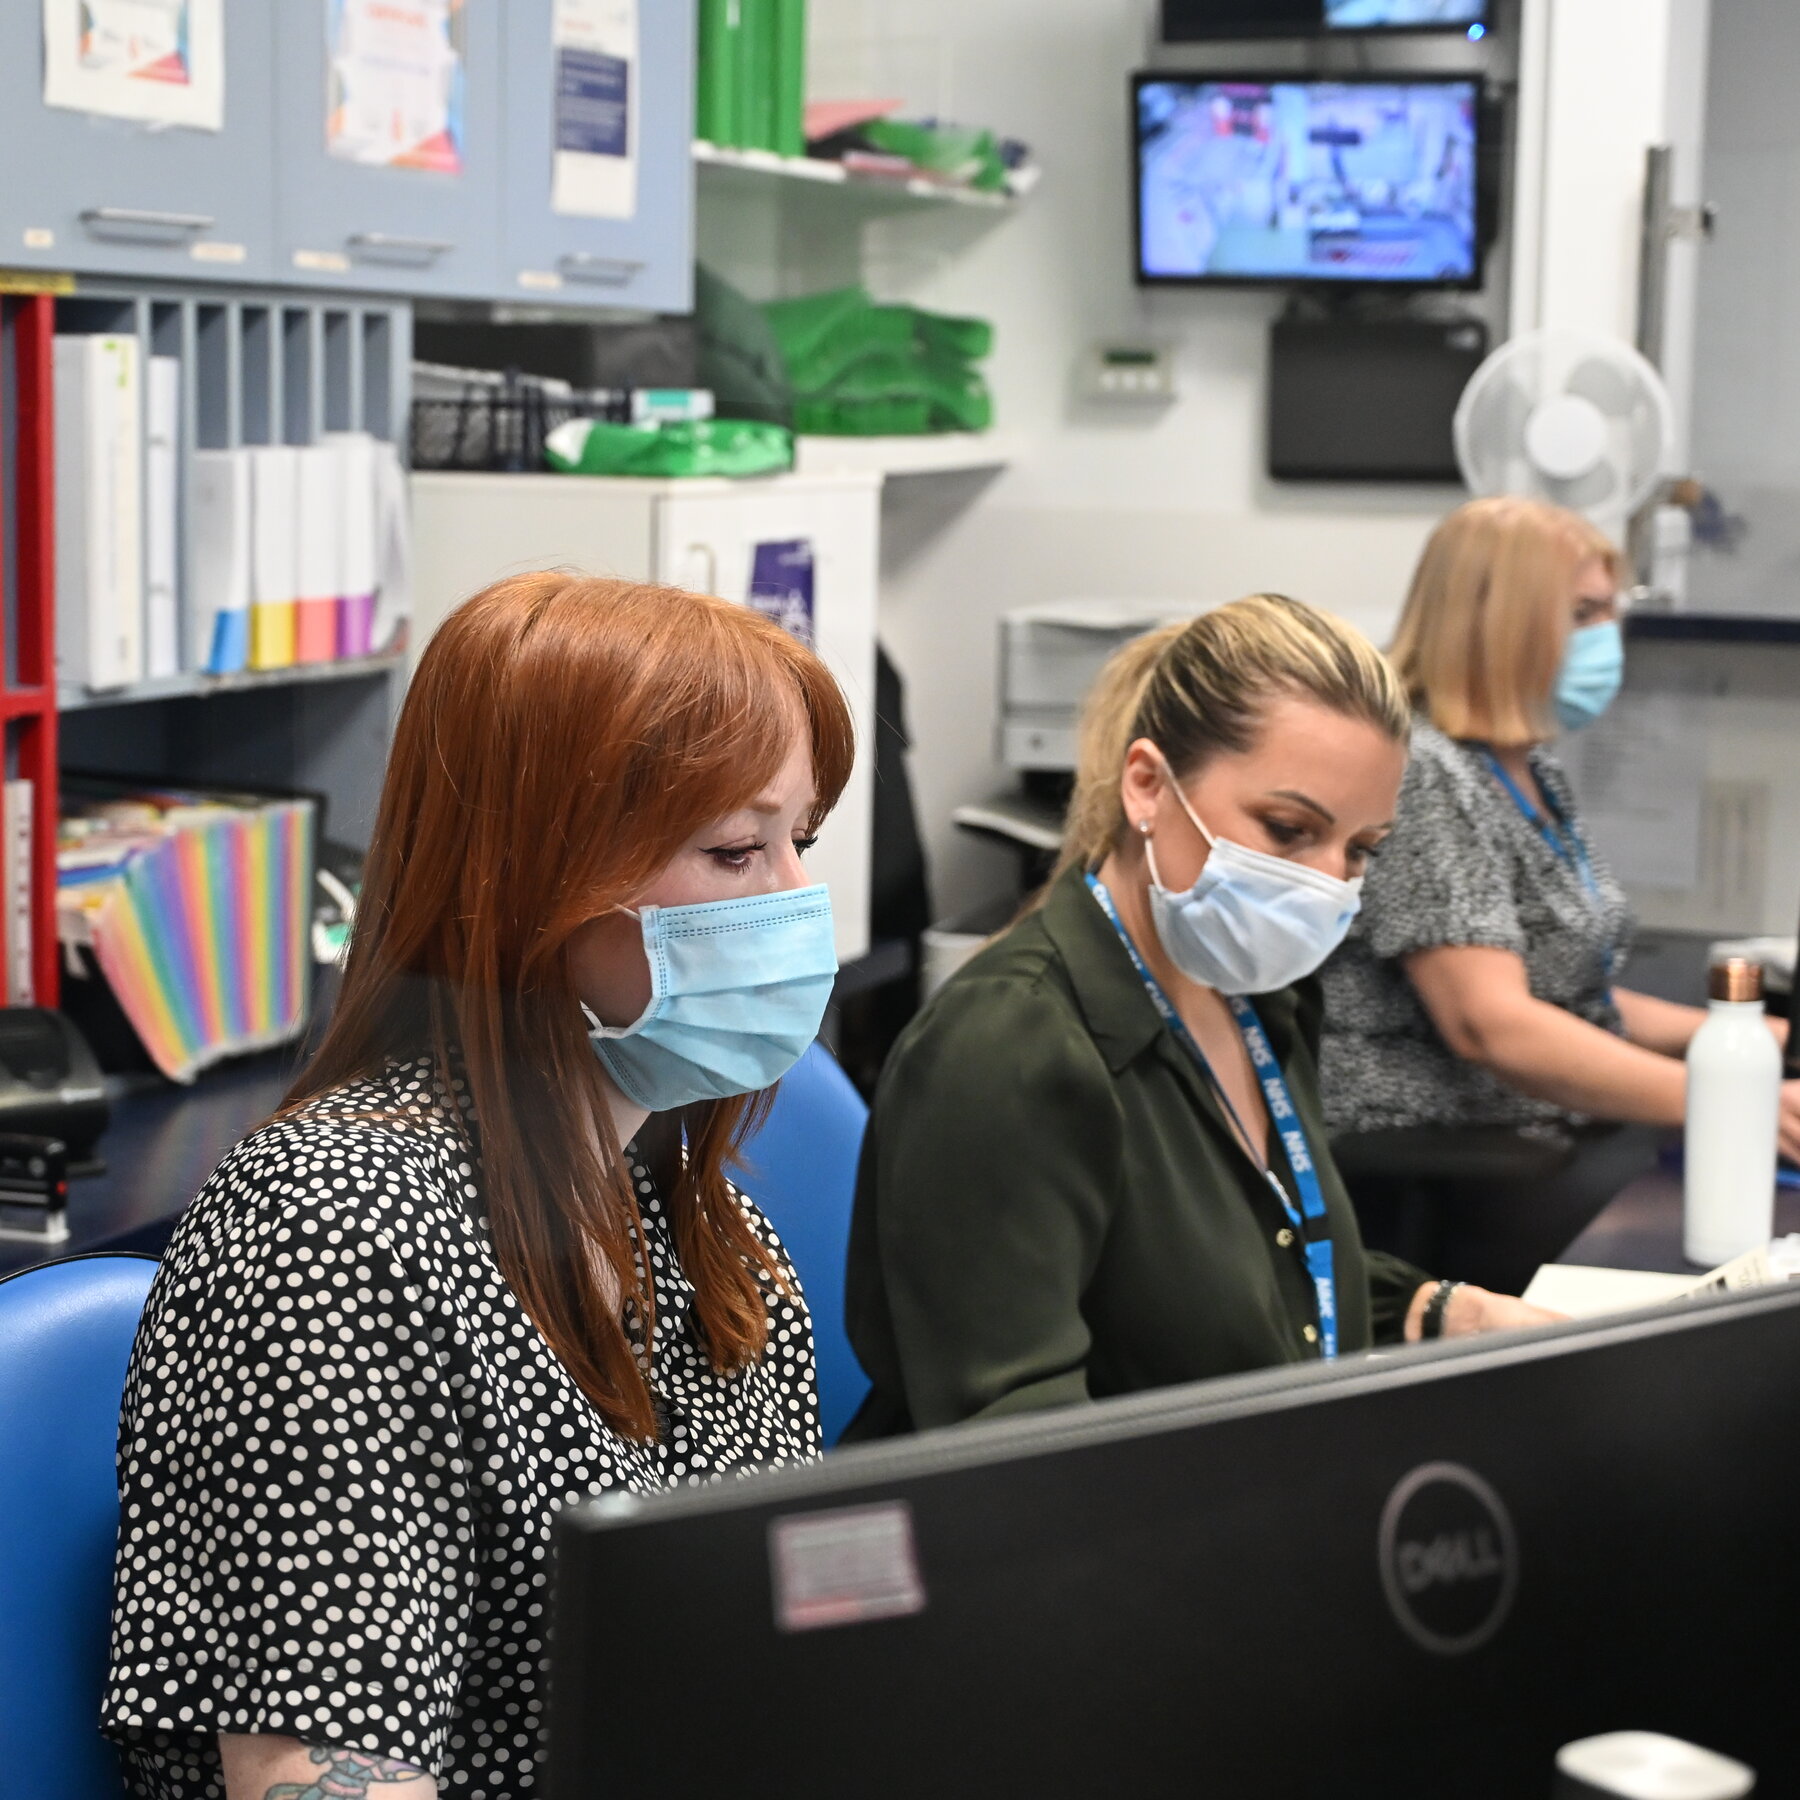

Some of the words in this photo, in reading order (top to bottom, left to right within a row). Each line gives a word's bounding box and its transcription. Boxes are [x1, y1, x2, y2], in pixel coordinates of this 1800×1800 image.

[1243, 1025, 1273, 1067] NHS
[1263, 1077, 1293, 1119] NHS
[1282, 1130, 1312, 1173] NHS
